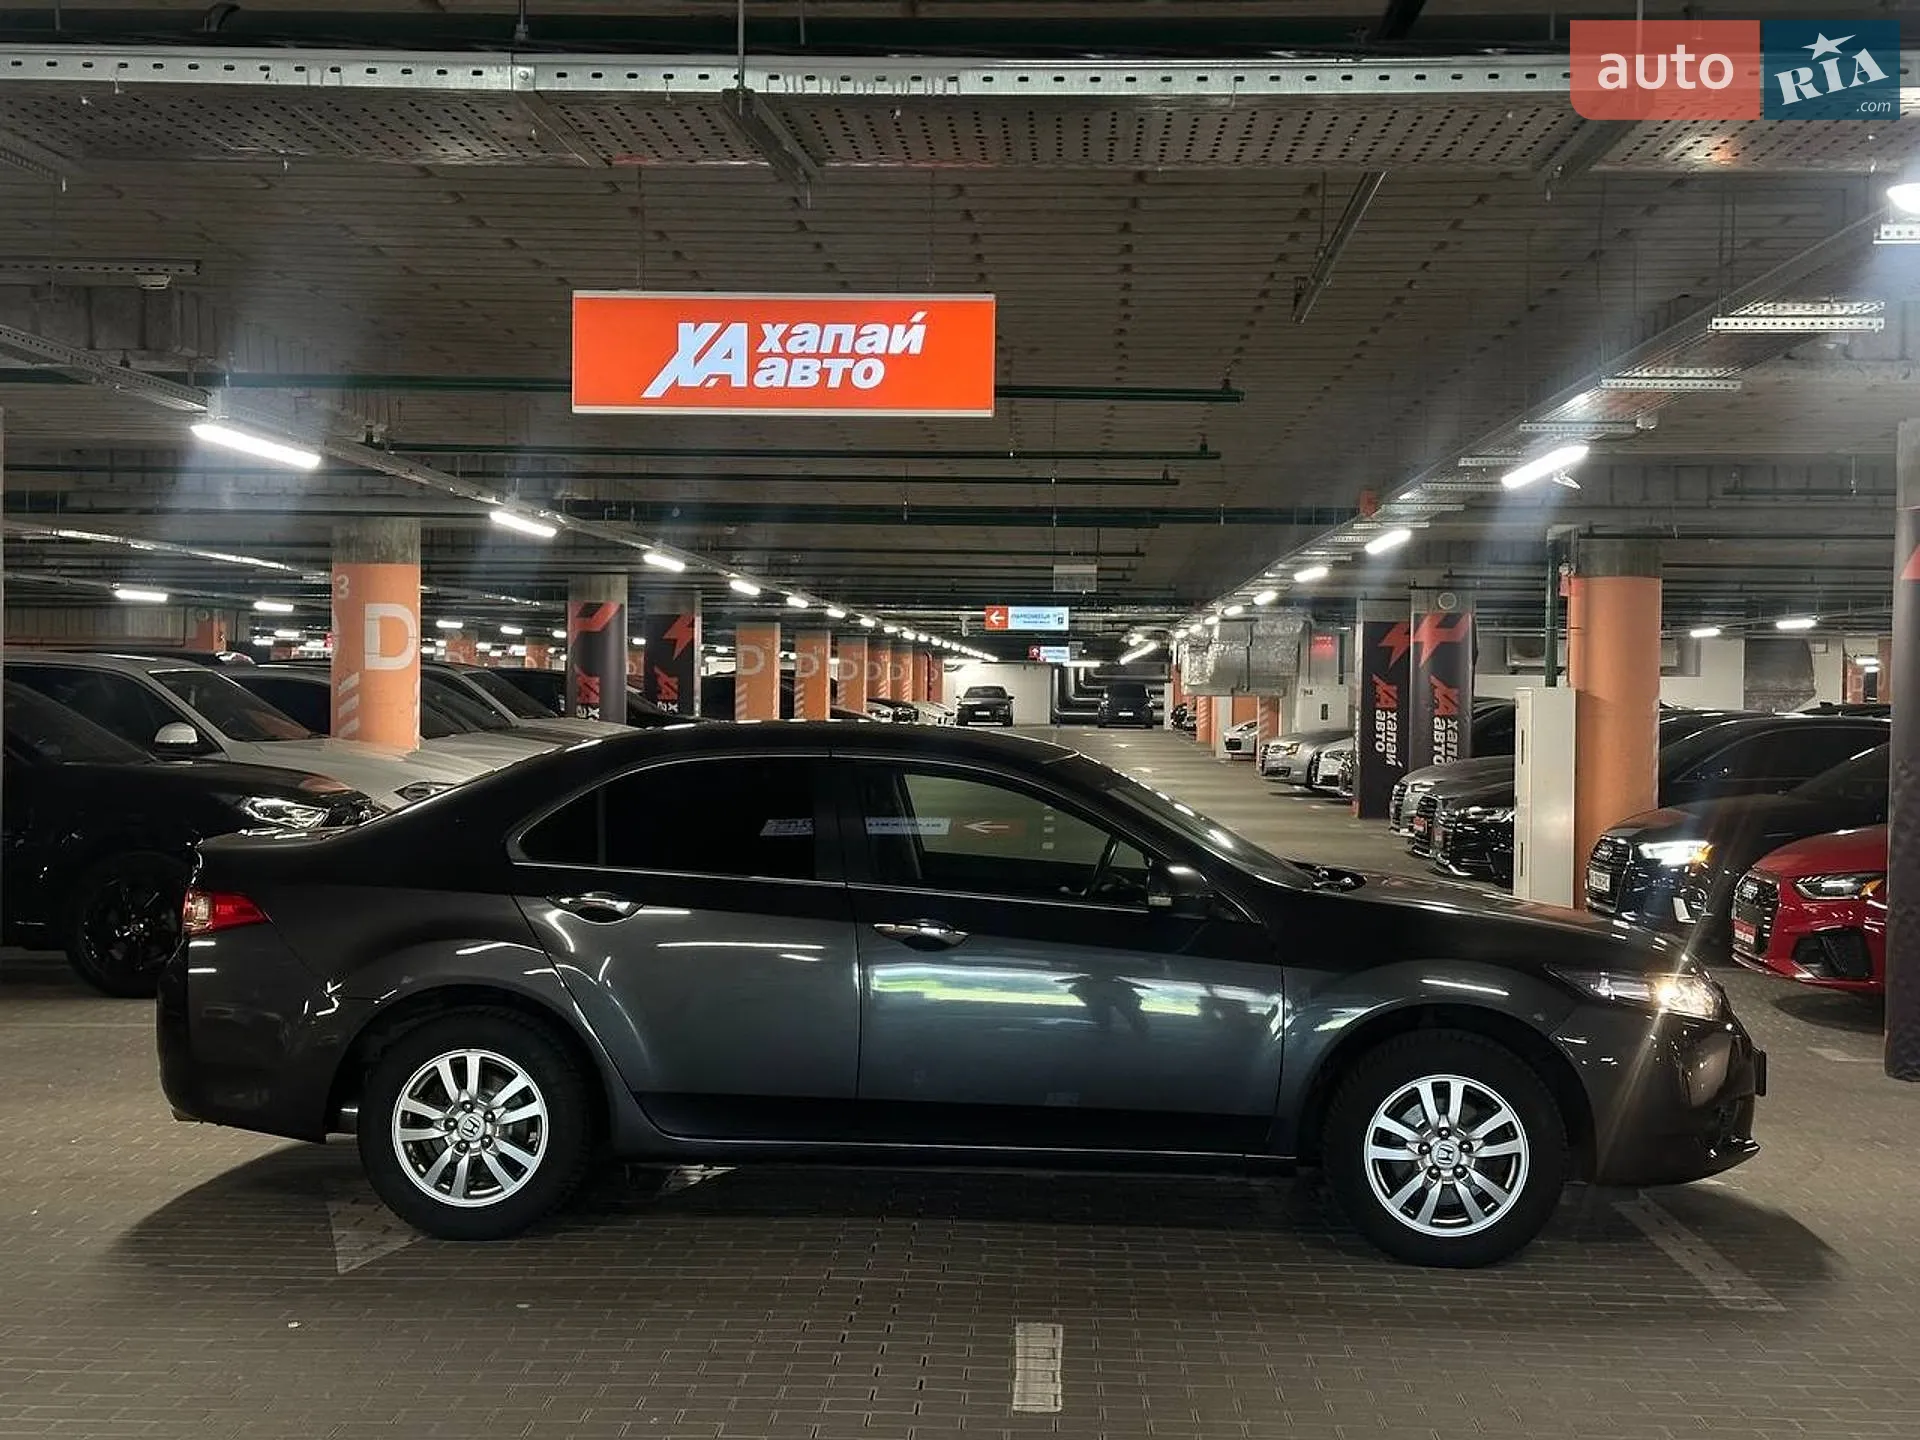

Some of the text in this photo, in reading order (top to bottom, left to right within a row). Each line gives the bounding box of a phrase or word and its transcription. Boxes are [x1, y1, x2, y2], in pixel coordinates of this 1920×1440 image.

[756, 311, 928, 355] хапай
[753, 356, 885, 389] авто
[365, 603, 417, 670] D
[736, 644, 765, 676] D
[797, 652, 819, 678] D
[839, 659, 858, 681] D
[1375, 709, 1386, 753] авто
[1386, 710, 1404, 768] хапай
[1433, 716, 1446, 766] авто
[1446, 718, 1459, 765] хапа
